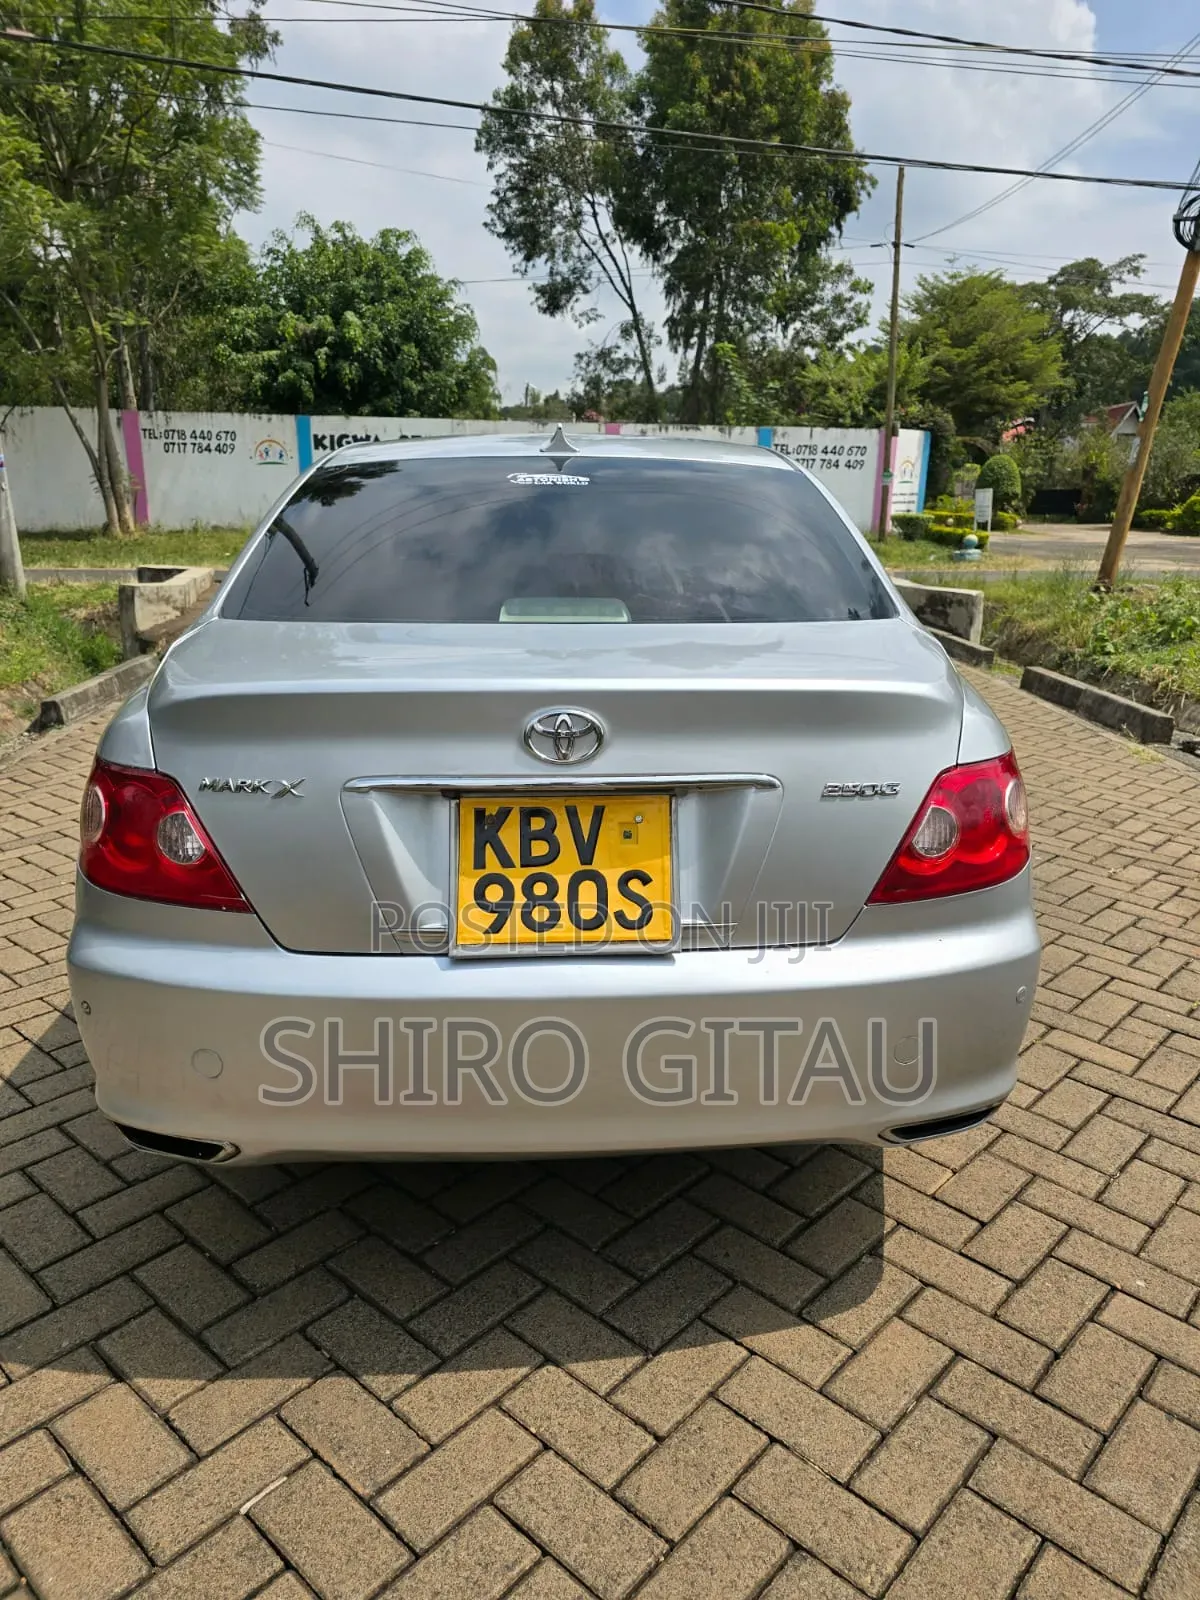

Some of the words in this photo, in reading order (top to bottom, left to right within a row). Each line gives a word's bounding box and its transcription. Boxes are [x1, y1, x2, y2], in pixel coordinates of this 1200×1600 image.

[189, 430, 212, 442] 440
[215, 430, 237, 442] 670
[163, 442, 187, 454] 0717
[190, 442, 213, 455] 784
[214, 443, 236, 455] 409
[821, 445, 845, 456] 440
[846, 446, 868, 457] 670
[819, 458, 840, 470] 784
[844, 459, 865, 470] 409
[198, 777, 272, 794] MARK
[271, 777, 306, 800] X
[821, 781, 902, 799] 250G
[473, 805, 606, 870] KBV
[473, 869, 653, 935] 980S
